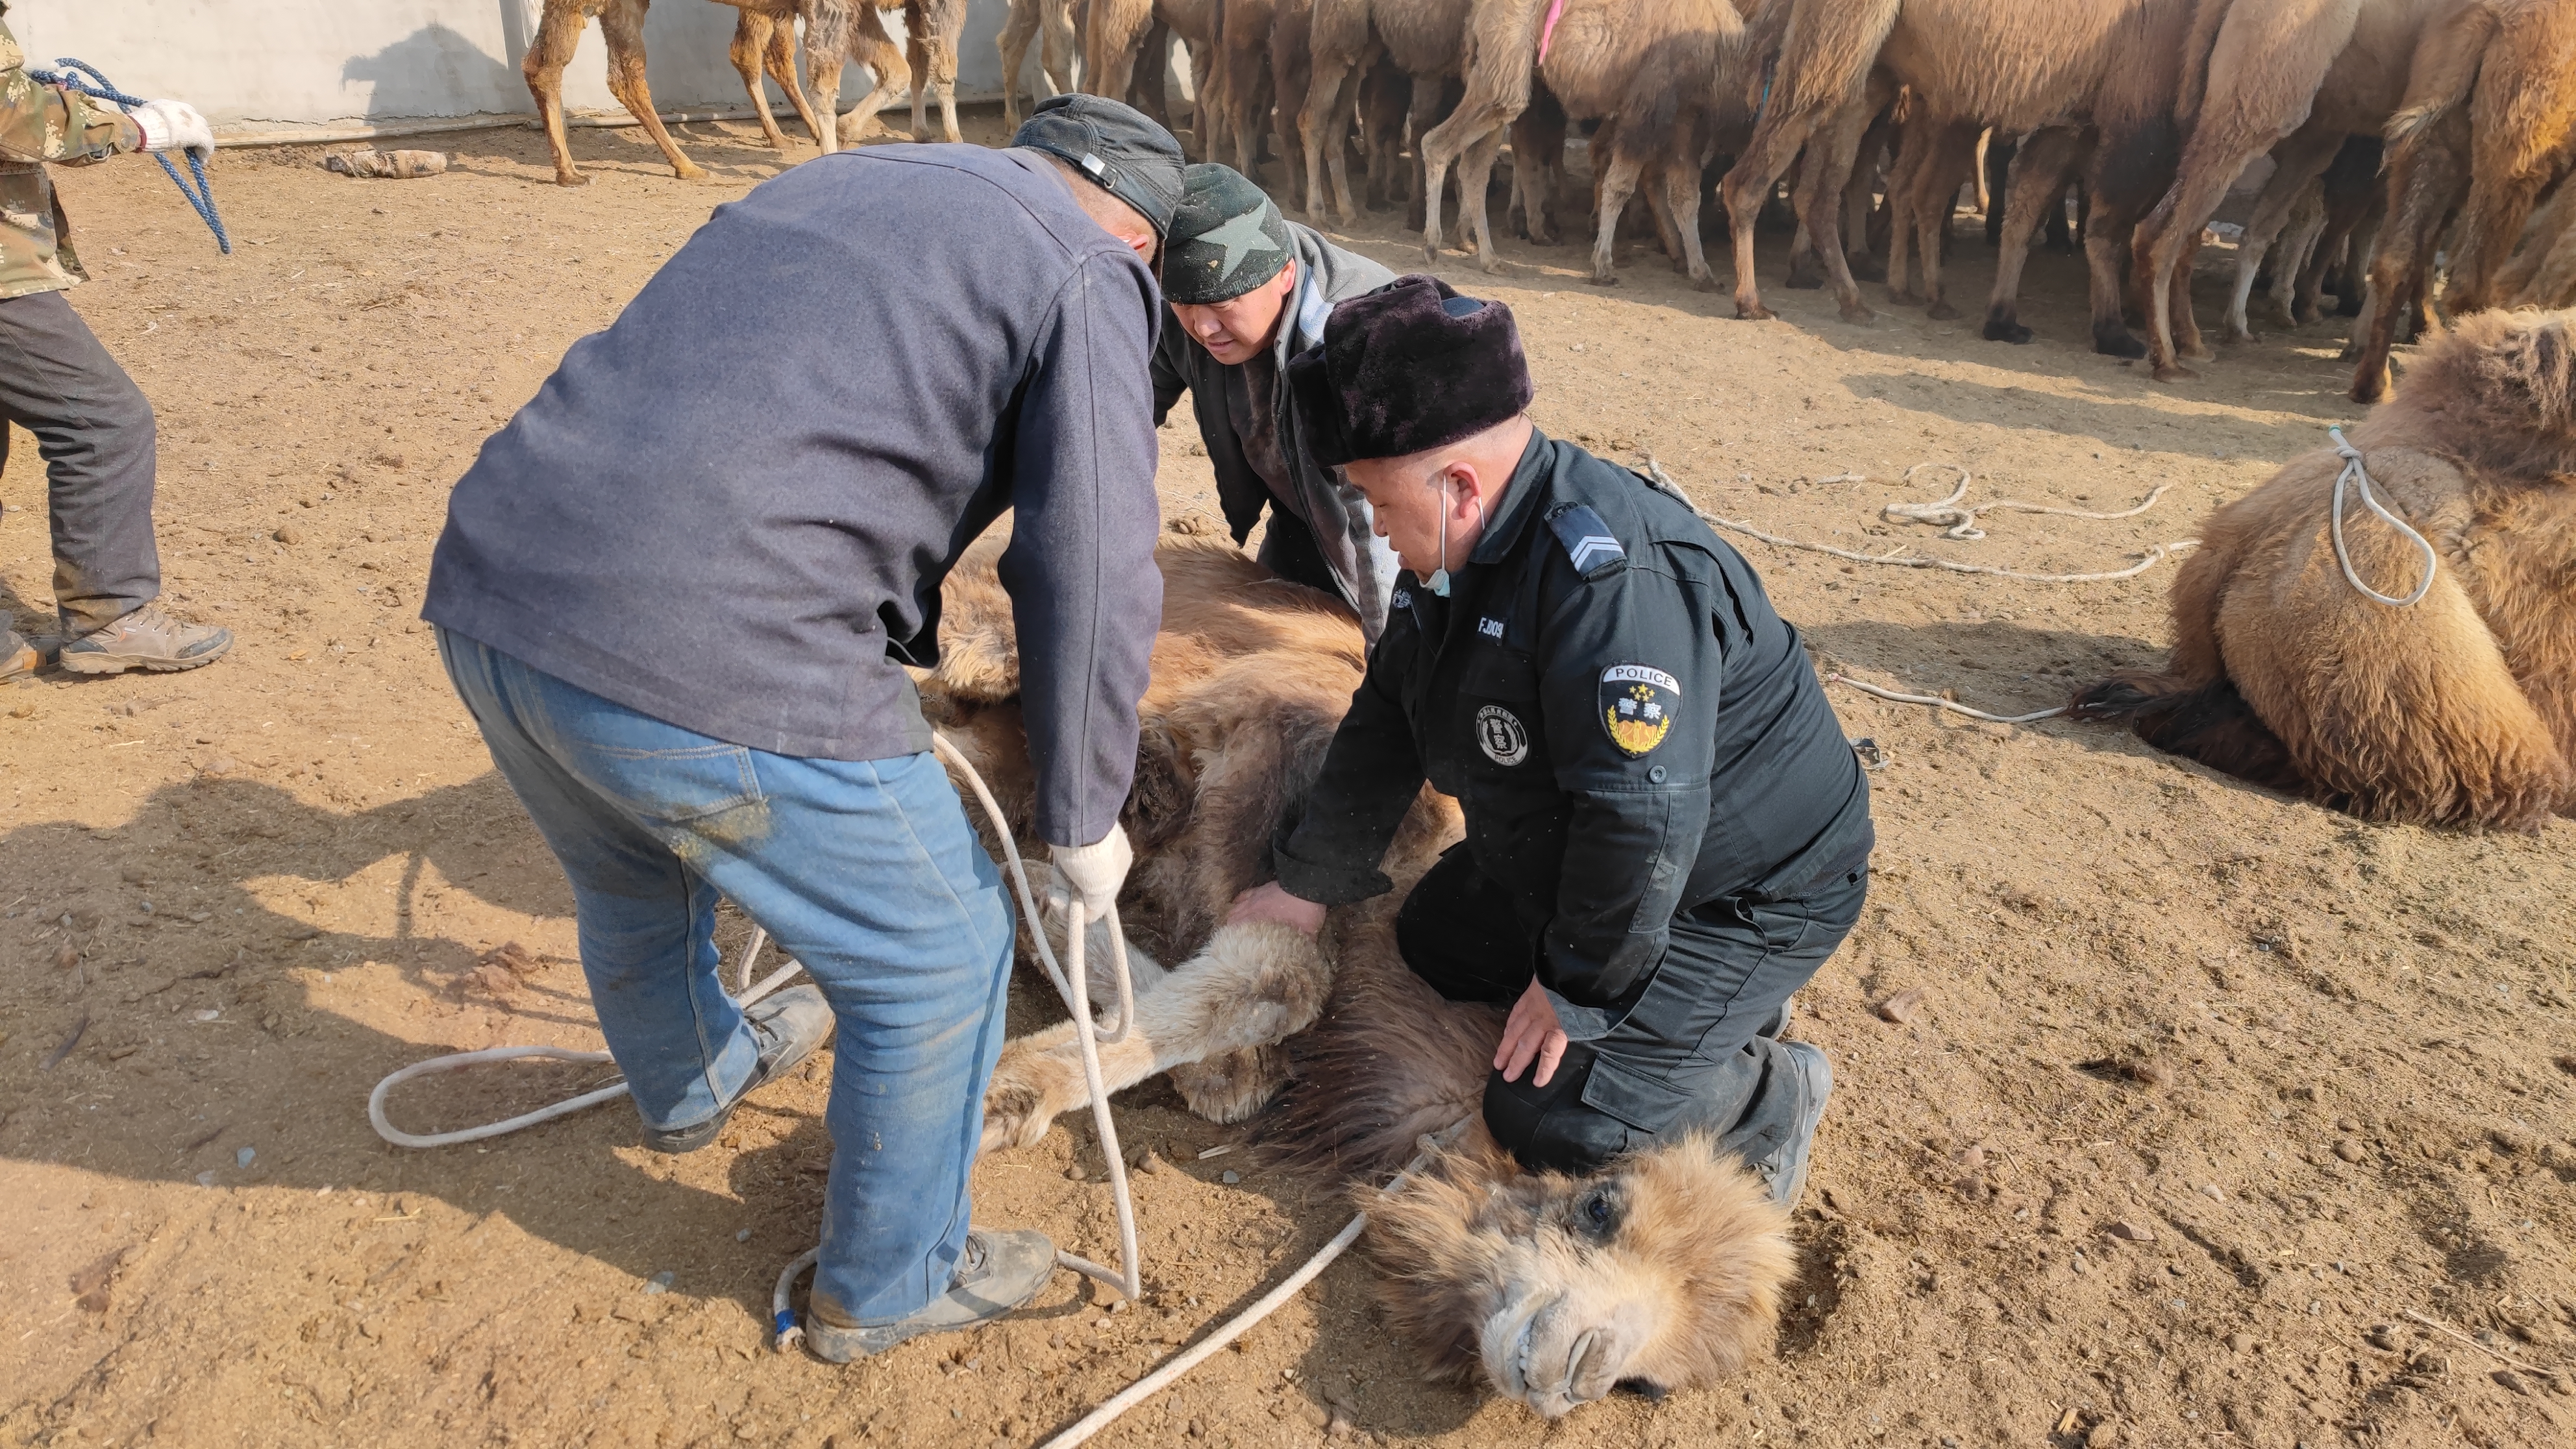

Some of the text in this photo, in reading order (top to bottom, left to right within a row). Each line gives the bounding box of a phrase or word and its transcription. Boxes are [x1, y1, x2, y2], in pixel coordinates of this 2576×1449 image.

[1615, 668, 1672, 687] POLICE
[1618, 697, 1662, 719] 警察
[1490, 718, 1507, 749] 警察
[1494, 754, 1518, 763] POLICE
